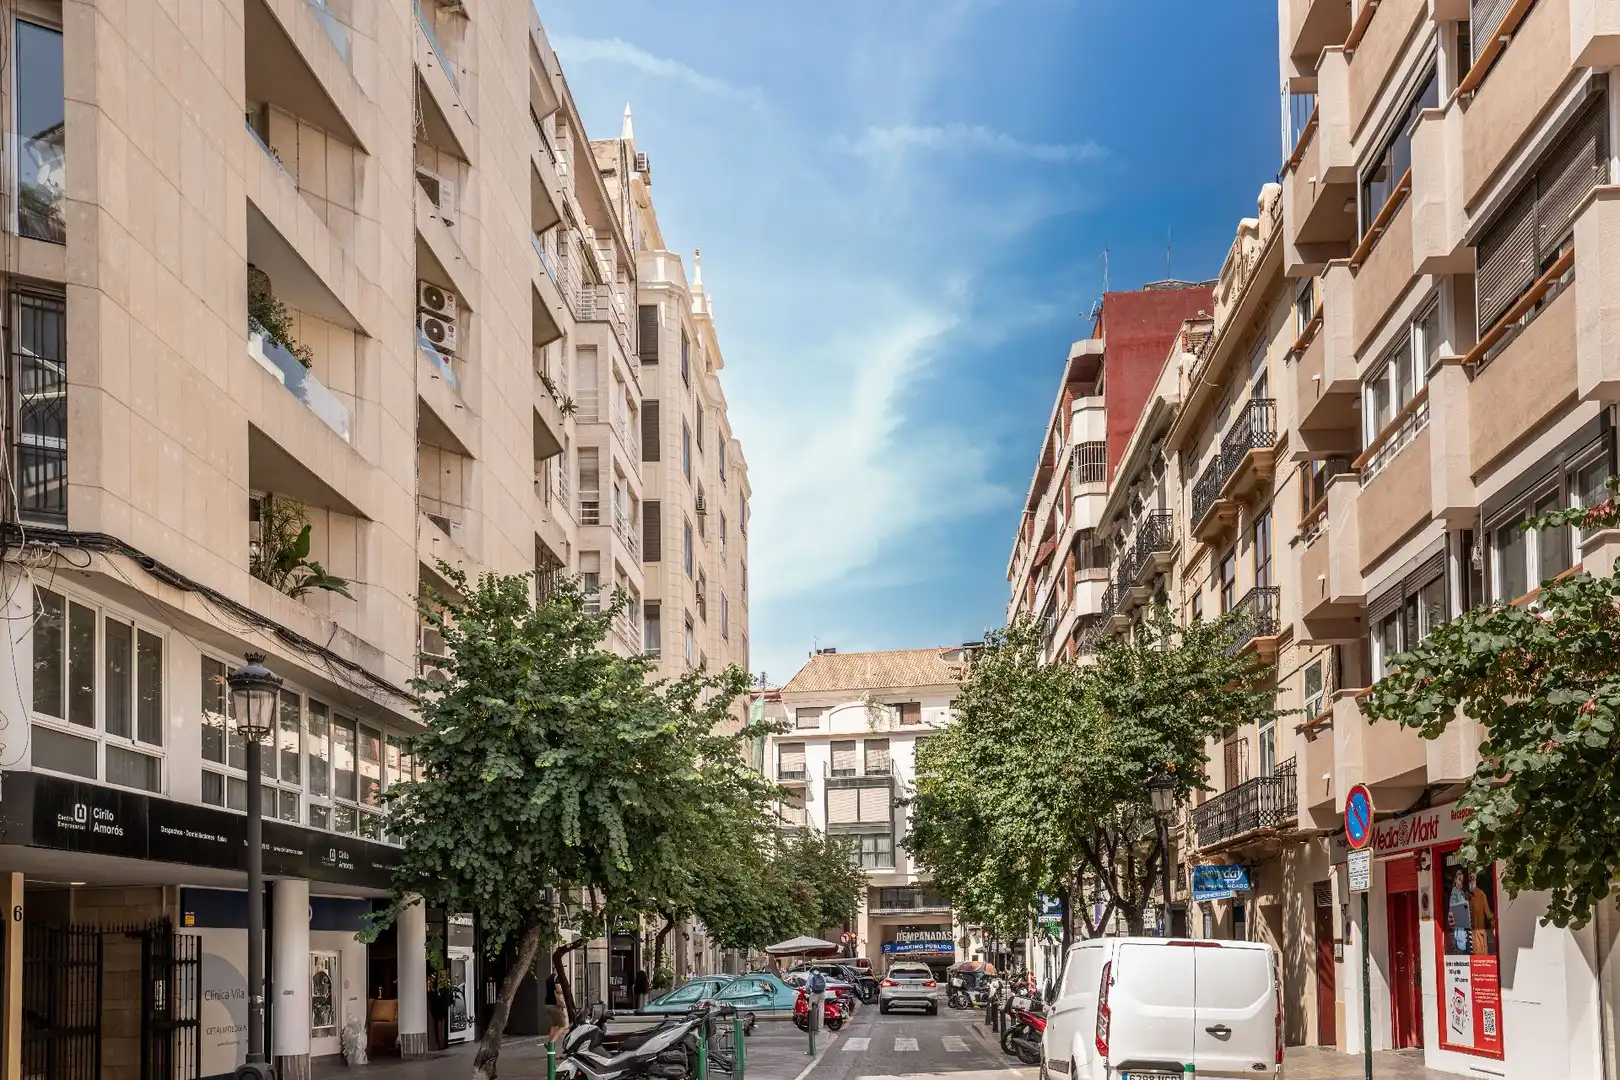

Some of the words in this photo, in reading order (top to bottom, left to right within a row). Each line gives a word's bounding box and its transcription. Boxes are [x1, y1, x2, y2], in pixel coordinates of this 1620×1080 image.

[93, 807, 115, 821] Cirilo
[93, 821, 124, 836] Amorós
[1369, 828, 1398, 850] Media
[1407, 814, 1439, 845] Markt
[14, 905, 23, 922] 6
[925, 942, 952, 950] PÚBLICO
[231, 988, 245, 999] Vila
